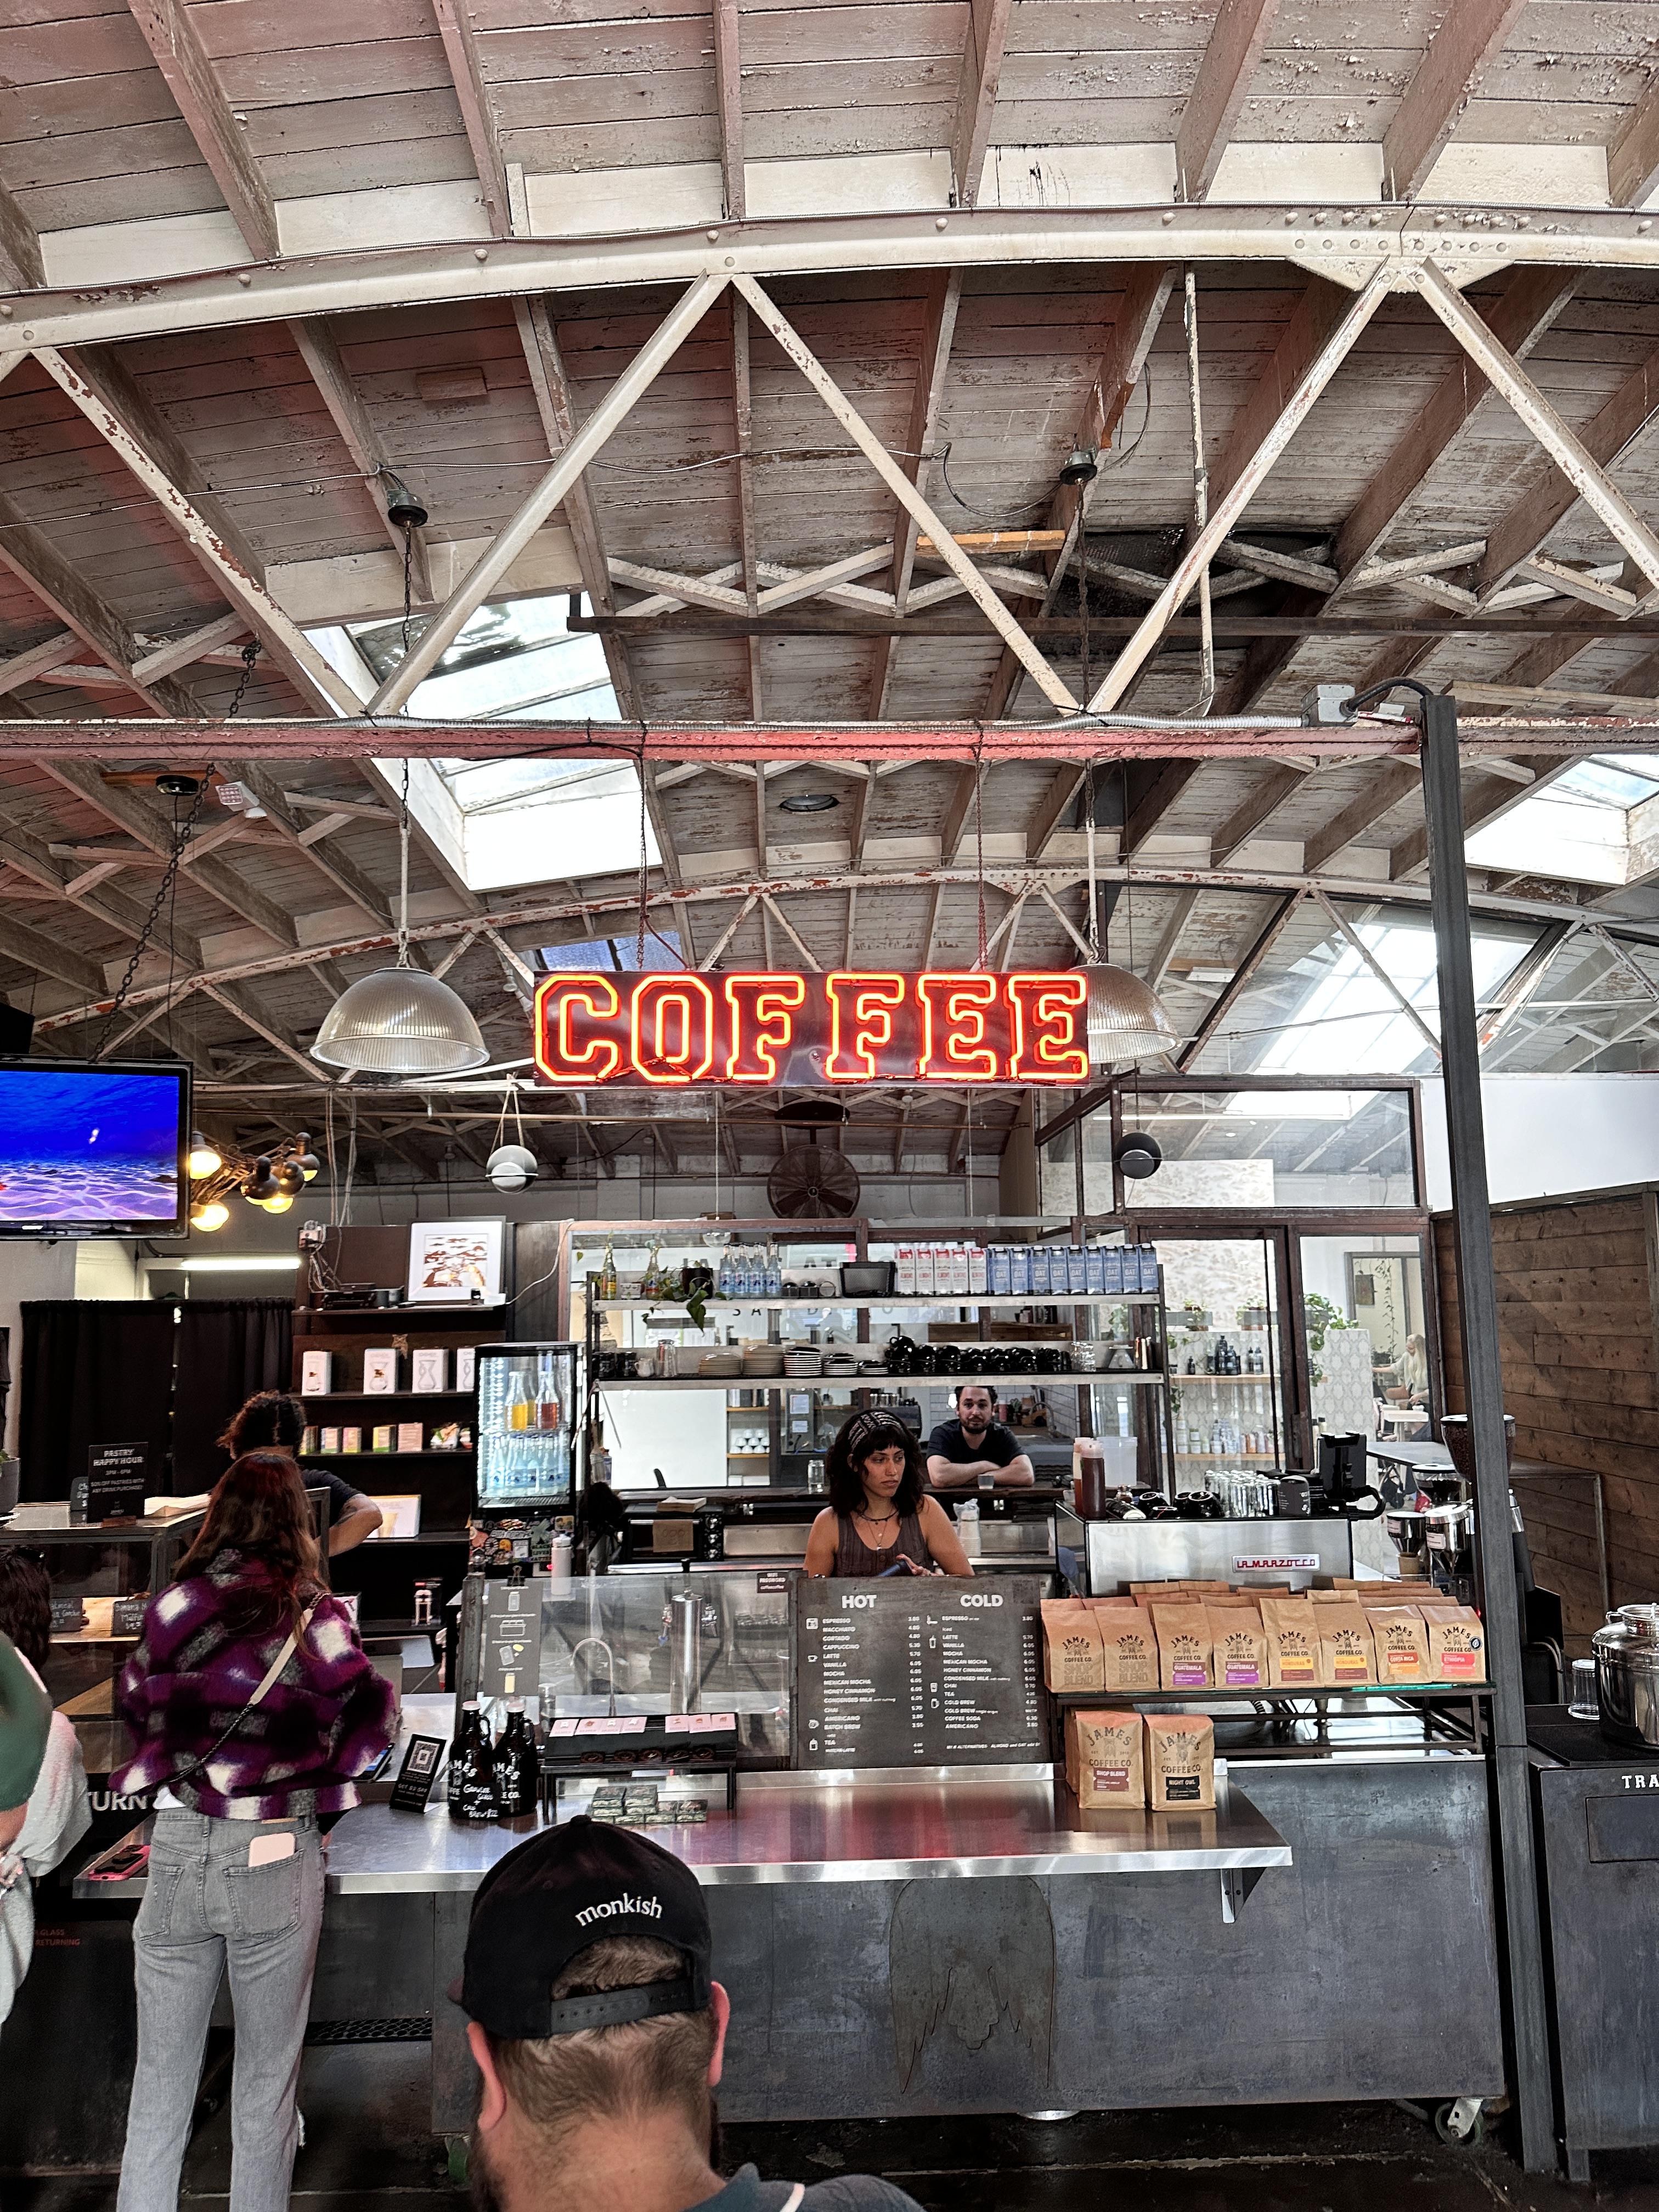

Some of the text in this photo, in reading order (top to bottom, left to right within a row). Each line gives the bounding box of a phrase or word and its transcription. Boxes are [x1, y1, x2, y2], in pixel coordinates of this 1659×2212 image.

[535, 973, 1088, 1083] COFFEE
[842, 1595, 877, 1609] HOT
[960, 1594, 1003, 1607] COLD
[1277, 1631, 1306, 1644] JAMES
[1332, 1629, 1361, 1643] JAMES
[1386, 1625, 1413, 1638] JAMES
[1442, 1627, 1471, 1639] JAMES
[1062, 1637, 1090, 1650] JAMES
[1116, 1634, 1144, 1647] JAMES
[1171, 1635, 1199, 1648] JAMES
[1224, 1633, 1253, 1646] JAMES
[1064, 1663, 1093, 1674] SHOP
[1119, 1661, 1148, 1673] SHOP
[1064, 1674, 1093, 1685] BLEND
[1119, 1673, 1148, 1683] BLEND
[1086, 1727, 1132, 1746] JAMES
[1159, 1731, 1201, 1753] JAMES
[1161, 1765, 1190, 1774] COFFEE
[1622, 1774, 1659, 1788] TRA
[88, 1791, 148, 1810] URN
[575, 1893, 663, 1926] monkish
